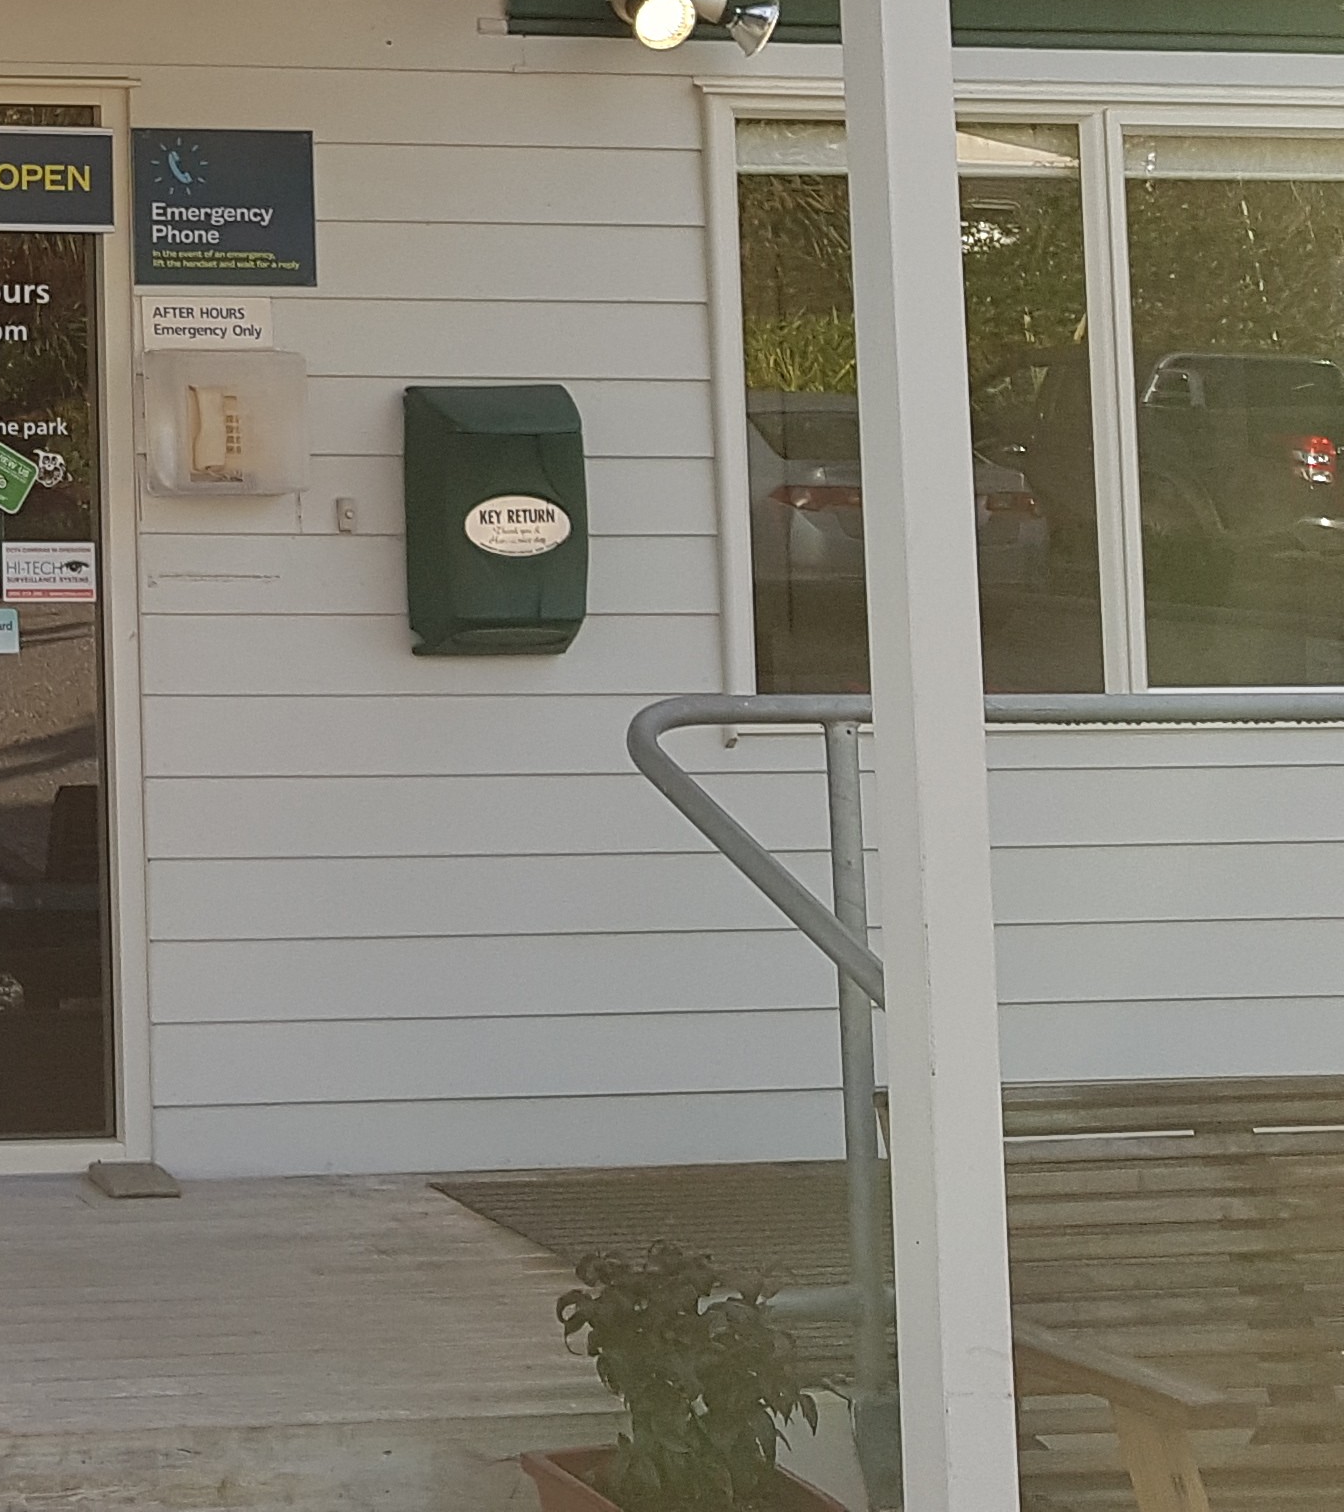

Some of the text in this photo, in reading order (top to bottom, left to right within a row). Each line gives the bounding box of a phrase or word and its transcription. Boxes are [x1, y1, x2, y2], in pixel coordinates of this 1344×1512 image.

[151, 202, 274, 227] Emergency
[152, 225, 220, 244] Phone
[162, 250, 177, 258] the
[204, 250, 214, 258] of
[152, 259, 165, 268] lift
[166, 260, 181, 268] the
[183, 259, 217, 268] handset
[219, 260, 236, 268] and
[237, 260, 255, 268] wait
[256, 260, 270, 268] for
[153, 306, 245, 320] AFTER HOURS
[154, 324, 262, 339] Emergency Only
[23, 418, 69, 439] park
[479, 508, 556, 525] KEY RETURN
[6, 561, 64, 575] HI-TECH
